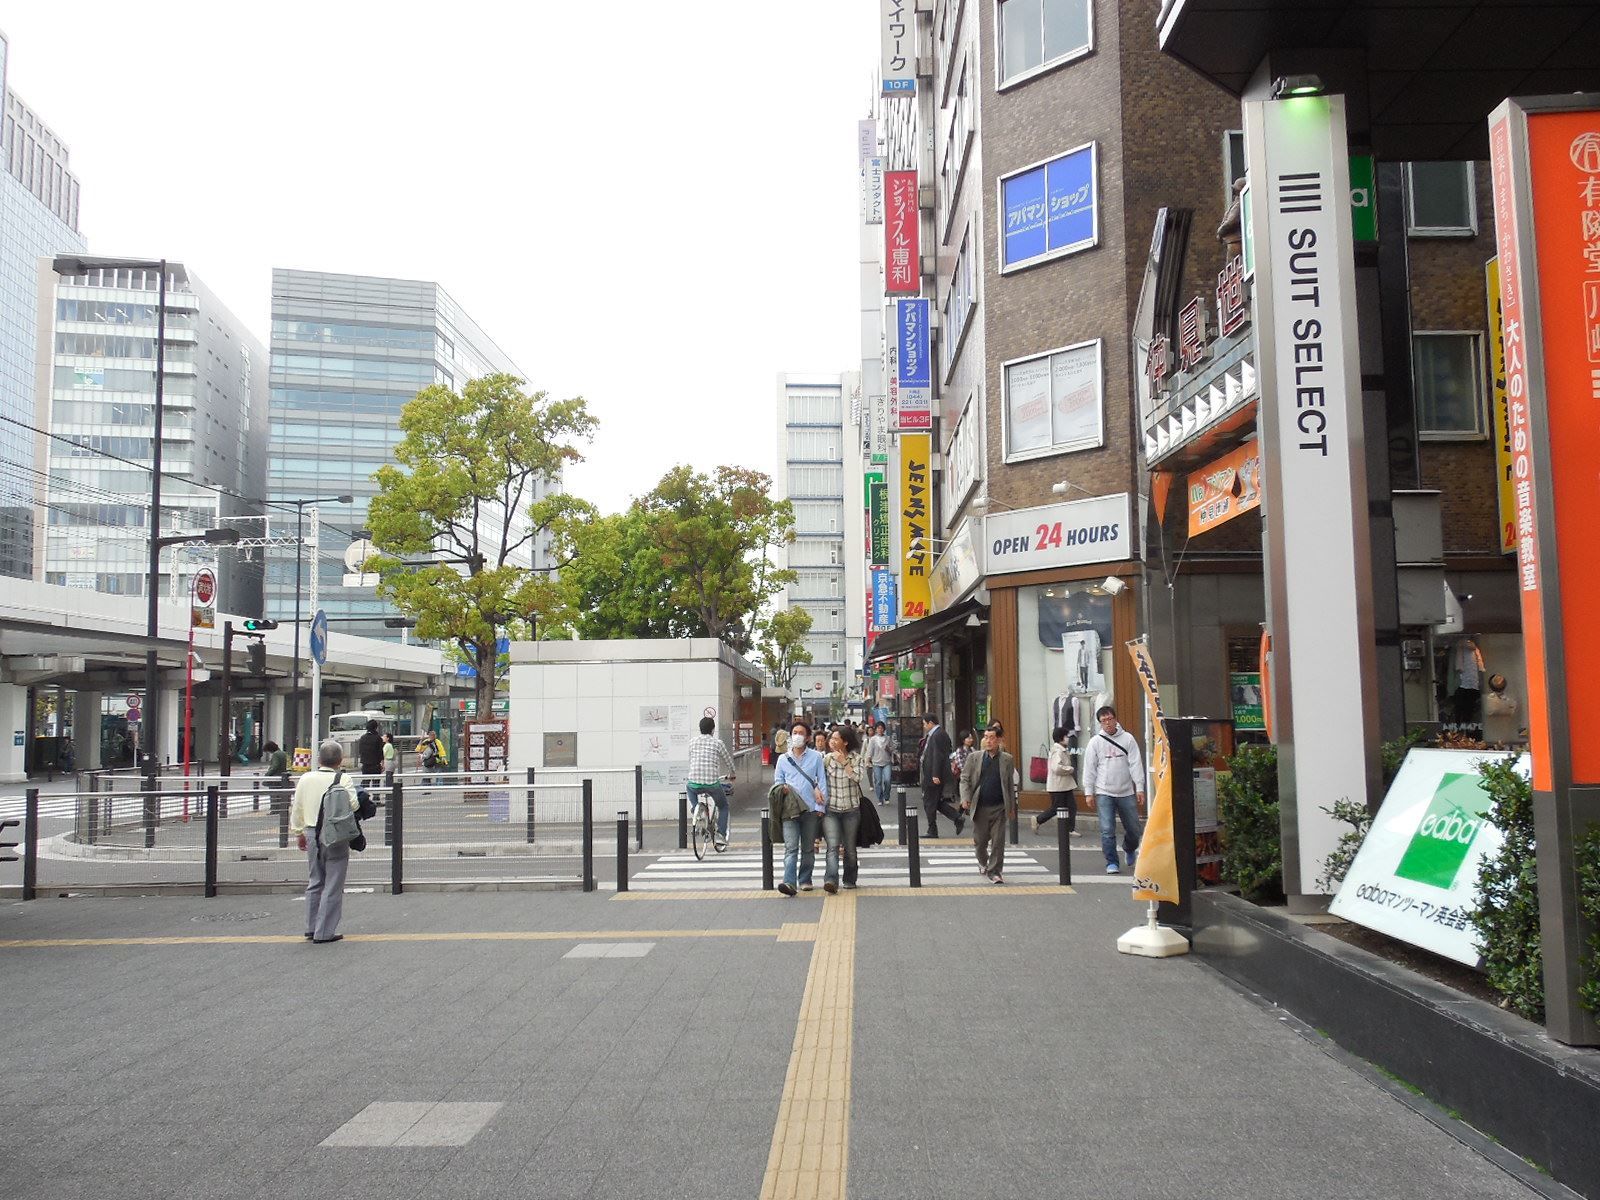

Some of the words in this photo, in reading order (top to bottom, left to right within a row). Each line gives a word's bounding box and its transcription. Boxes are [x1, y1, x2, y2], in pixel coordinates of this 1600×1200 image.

[892, 179, 911, 284] ジョイフル恵利
[1008, 183, 1090, 228] アパマンショップ
[1288, 229, 1320, 308] SUIT
[1292, 319, 1328, 457] SELECT
[1506, 318, 1537, 591] 大人のための音楽教室
[903, 460, 926, 518] JEANS
[904, 521, 926, 577] MATE
[993, 536, 1029, 556] OPEN
[1035, 522, 1063, 551] 24
[1067, 523, 1119, 547] HOURS
[878, 573, 888, 625] 京急不動産
